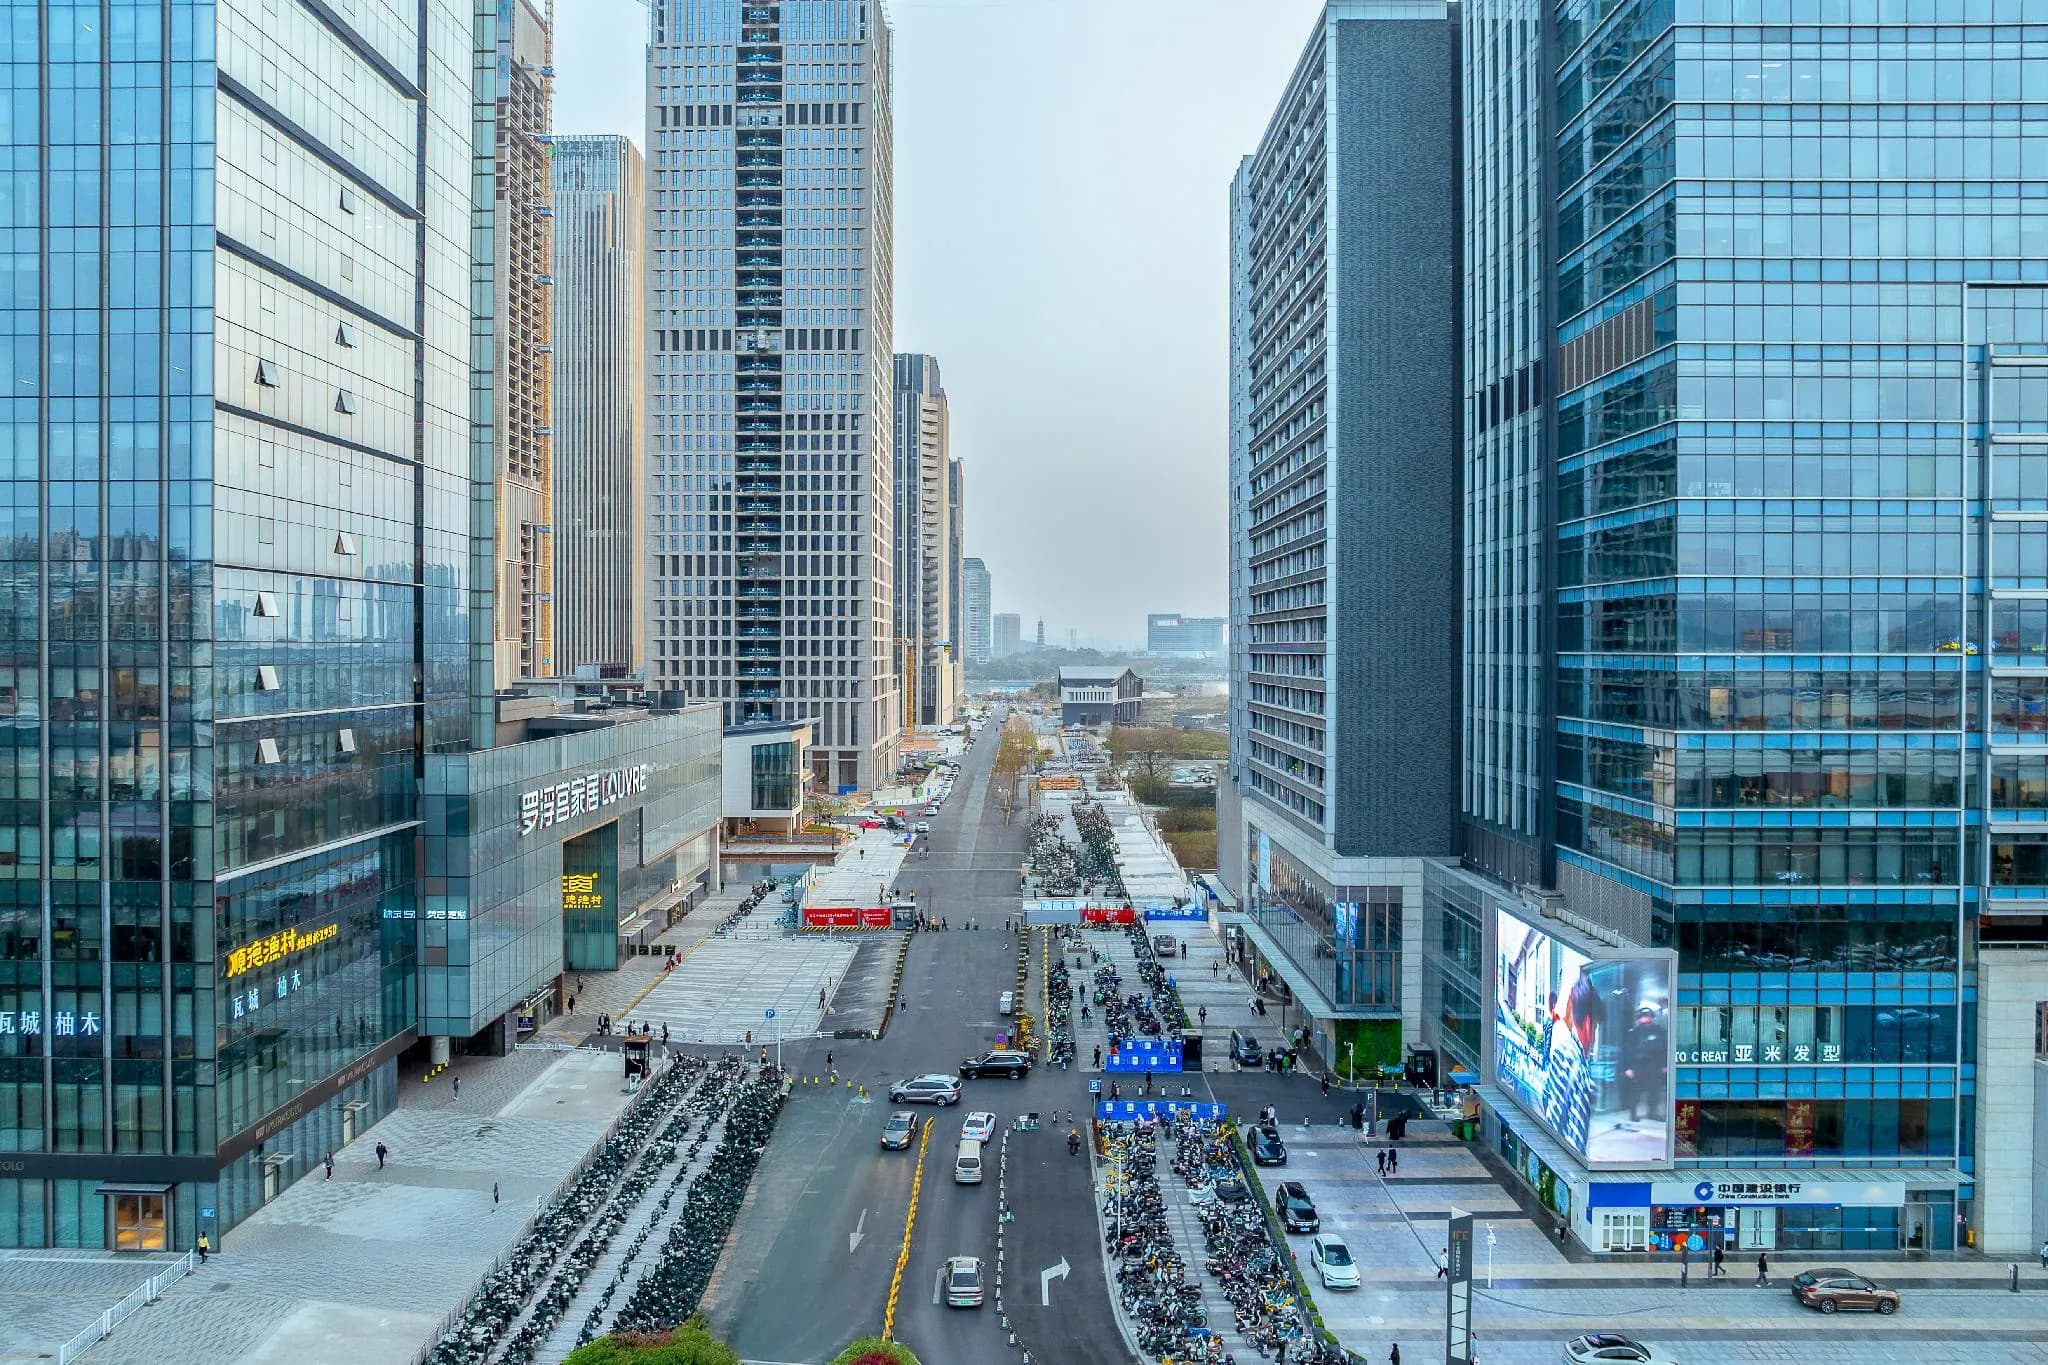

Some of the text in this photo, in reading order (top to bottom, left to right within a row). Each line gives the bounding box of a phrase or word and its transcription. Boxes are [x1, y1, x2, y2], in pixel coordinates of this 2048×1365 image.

[521, 764, 647, 836] 罗浮宫家居 LOUVRE
[0, 1011, 100, 1036] 瓦城 柚木
[1735, 1044, 1841, 1063] 亚米发型
[1367, 1093, 1373, 1101] P
[1718, 1183, 1801, 1194] 中国建设银行
